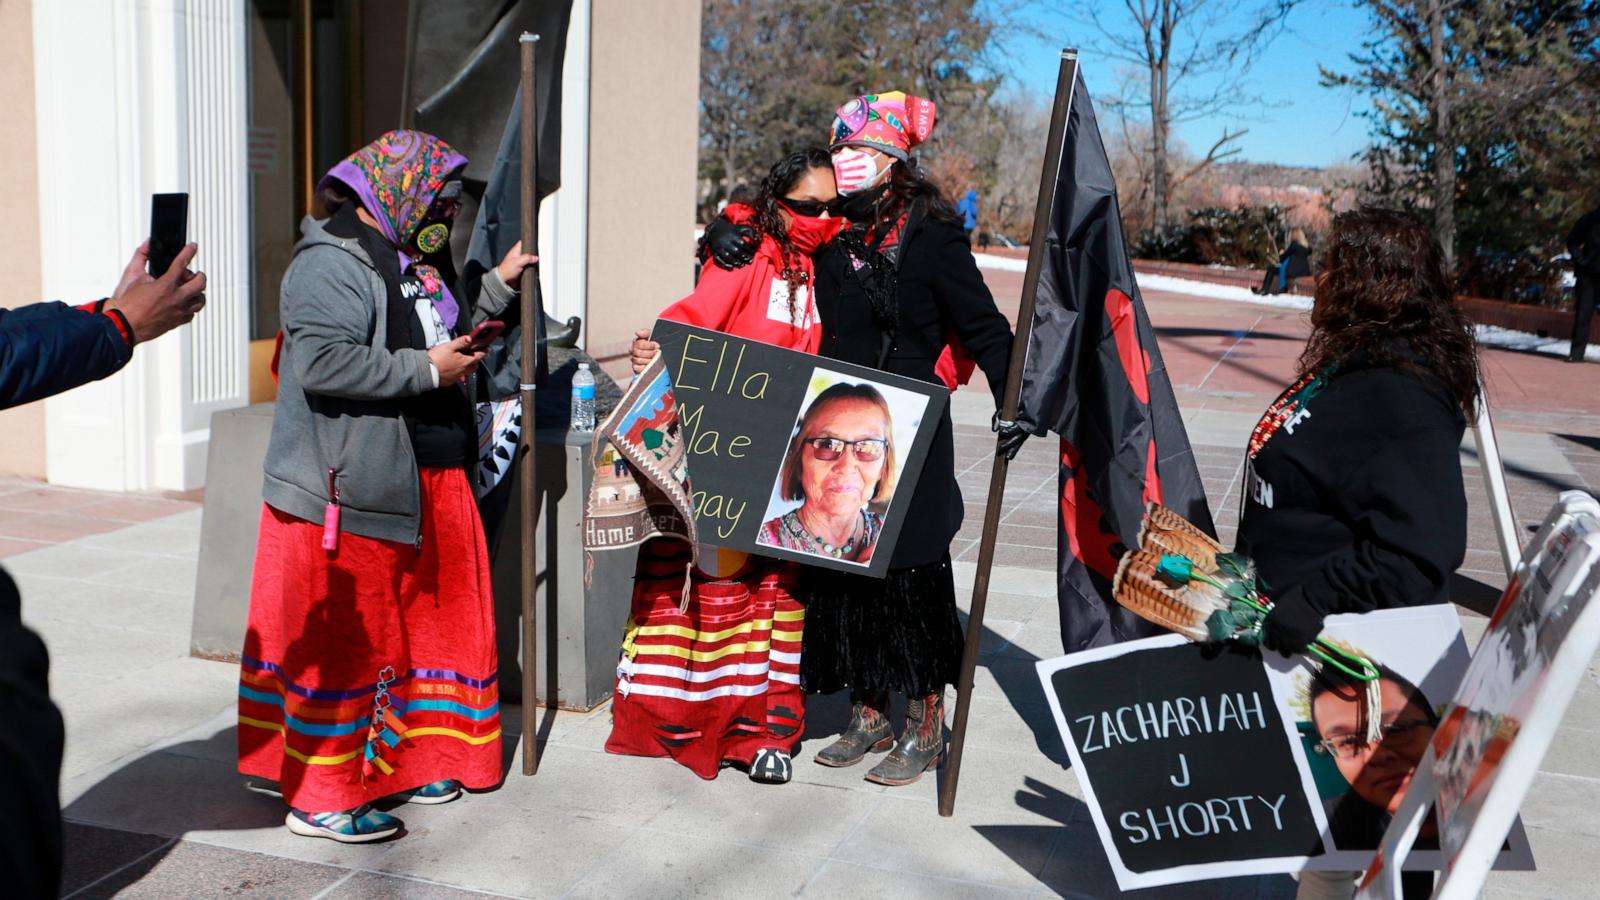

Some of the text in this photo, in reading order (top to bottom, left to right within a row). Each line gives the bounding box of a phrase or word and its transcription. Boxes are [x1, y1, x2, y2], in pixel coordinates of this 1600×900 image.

[675, 334, 769, 399] Ella
[677, 403, 751, 458] Mae
[586, 519, 634, 546] Home
[1075, 691, 1266, 754] ZACHARIAH
[1169, 753, 1190, 787] J
[1119, 794, 1286, 844] SHORTY
